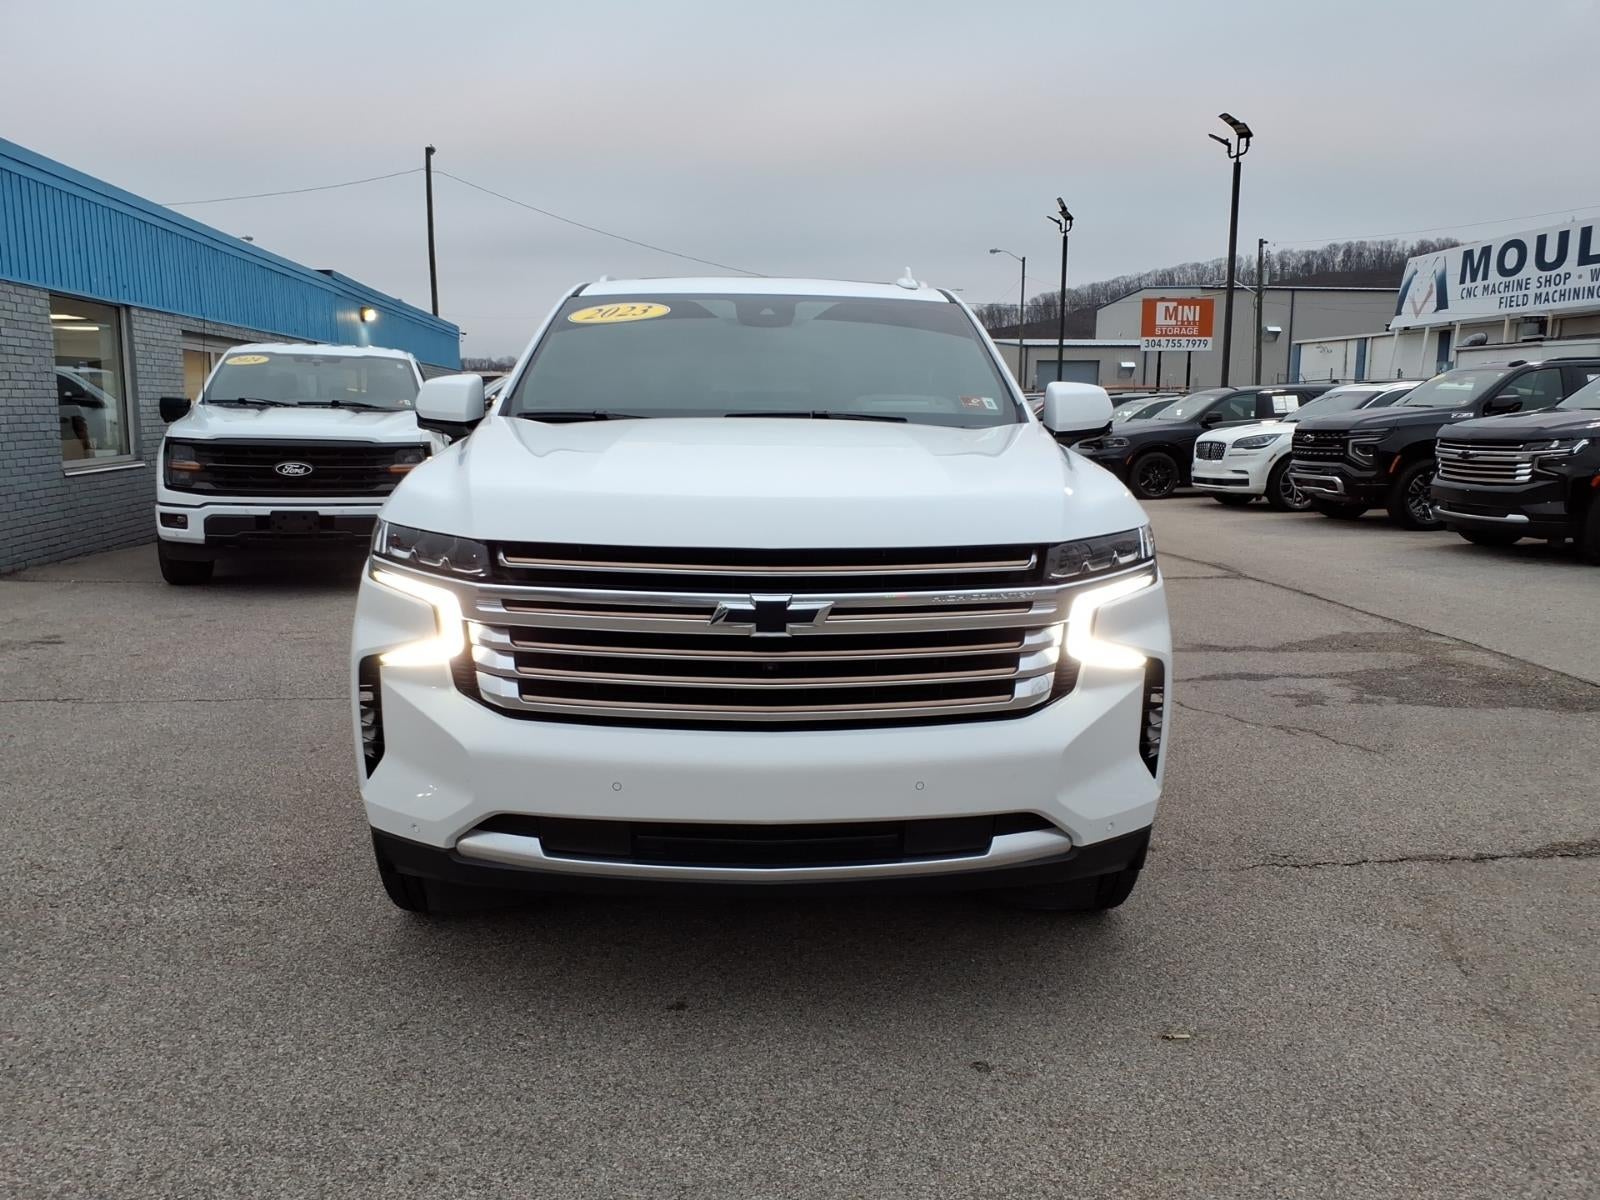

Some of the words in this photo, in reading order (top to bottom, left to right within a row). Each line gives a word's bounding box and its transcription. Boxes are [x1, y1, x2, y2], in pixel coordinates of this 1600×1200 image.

[1459, 225, 1600, 286] MOUL
[1460, 286, 1479, 300] CNC
[1481, 277, 1532, 297] MACHINE
[1536, 272, 1572, 289] SHOP
[1498, 293, 1529, 310] FIELD
[583, 304, 655, 320] 2023
[1161, 304, 1200, 322] MINI
[1155, 327, 1199, 335] STORAGE
[1144, 338, 1209, 349] 304.755.7979
[282, 464, 305, 474] Ford
